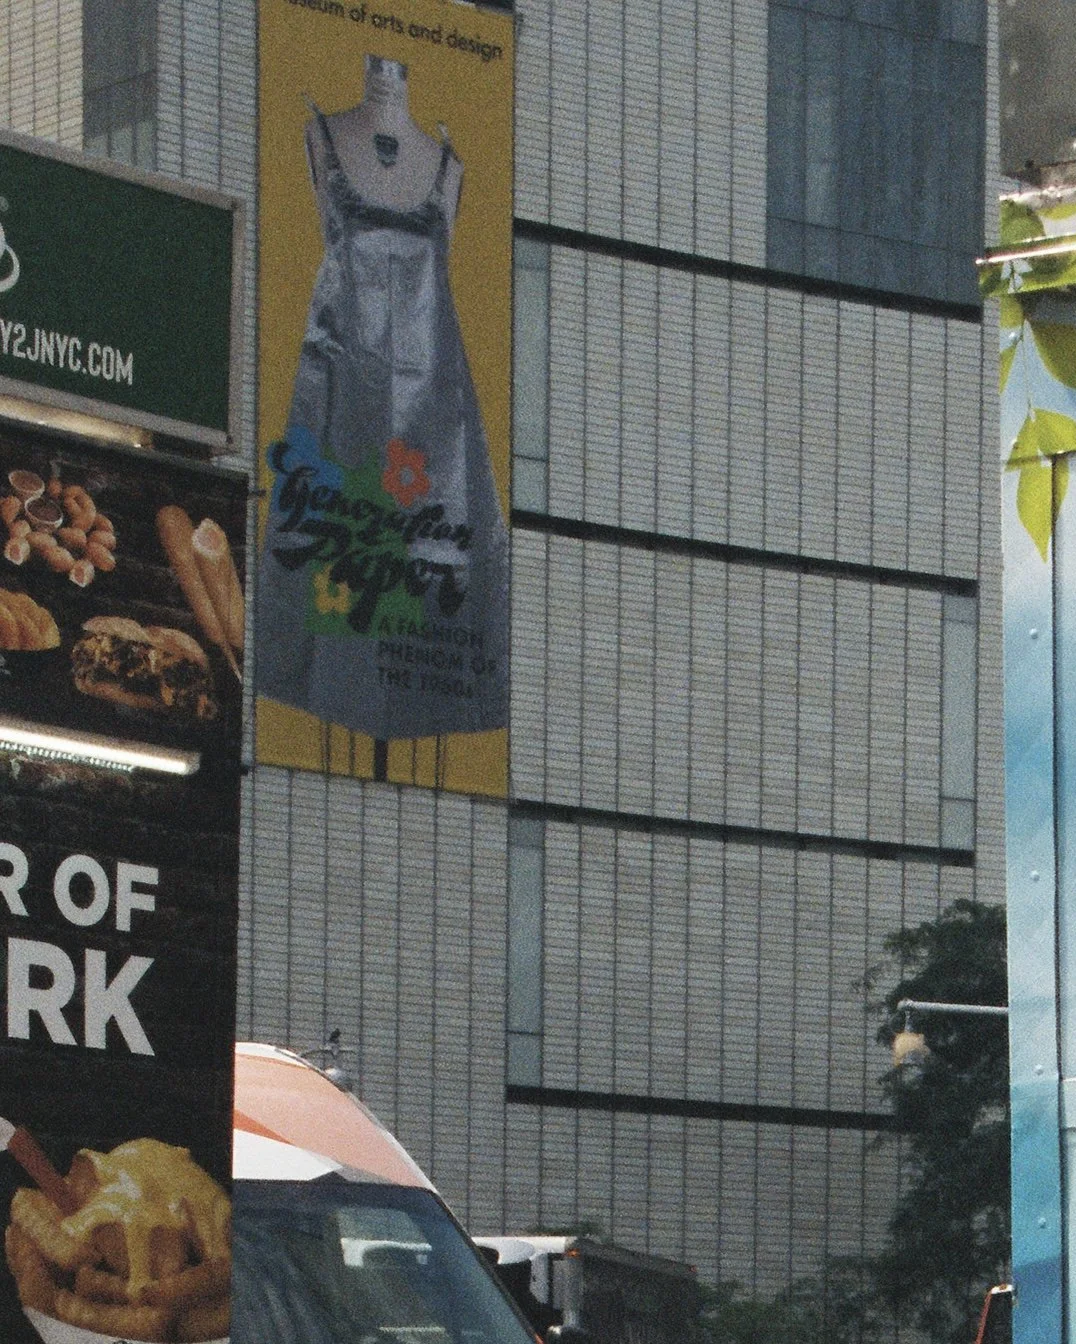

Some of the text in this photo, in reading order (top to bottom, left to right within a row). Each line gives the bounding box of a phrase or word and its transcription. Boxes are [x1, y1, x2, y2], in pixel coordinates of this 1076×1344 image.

[350, 5, 366, 23] of
[371, 13, 404, 34] arts
[408, 23, 442, 44] and
[446, 28, 502, 62] design
[53, 854, 159, 932] OF
[7, 937, 155, 1056] RK
